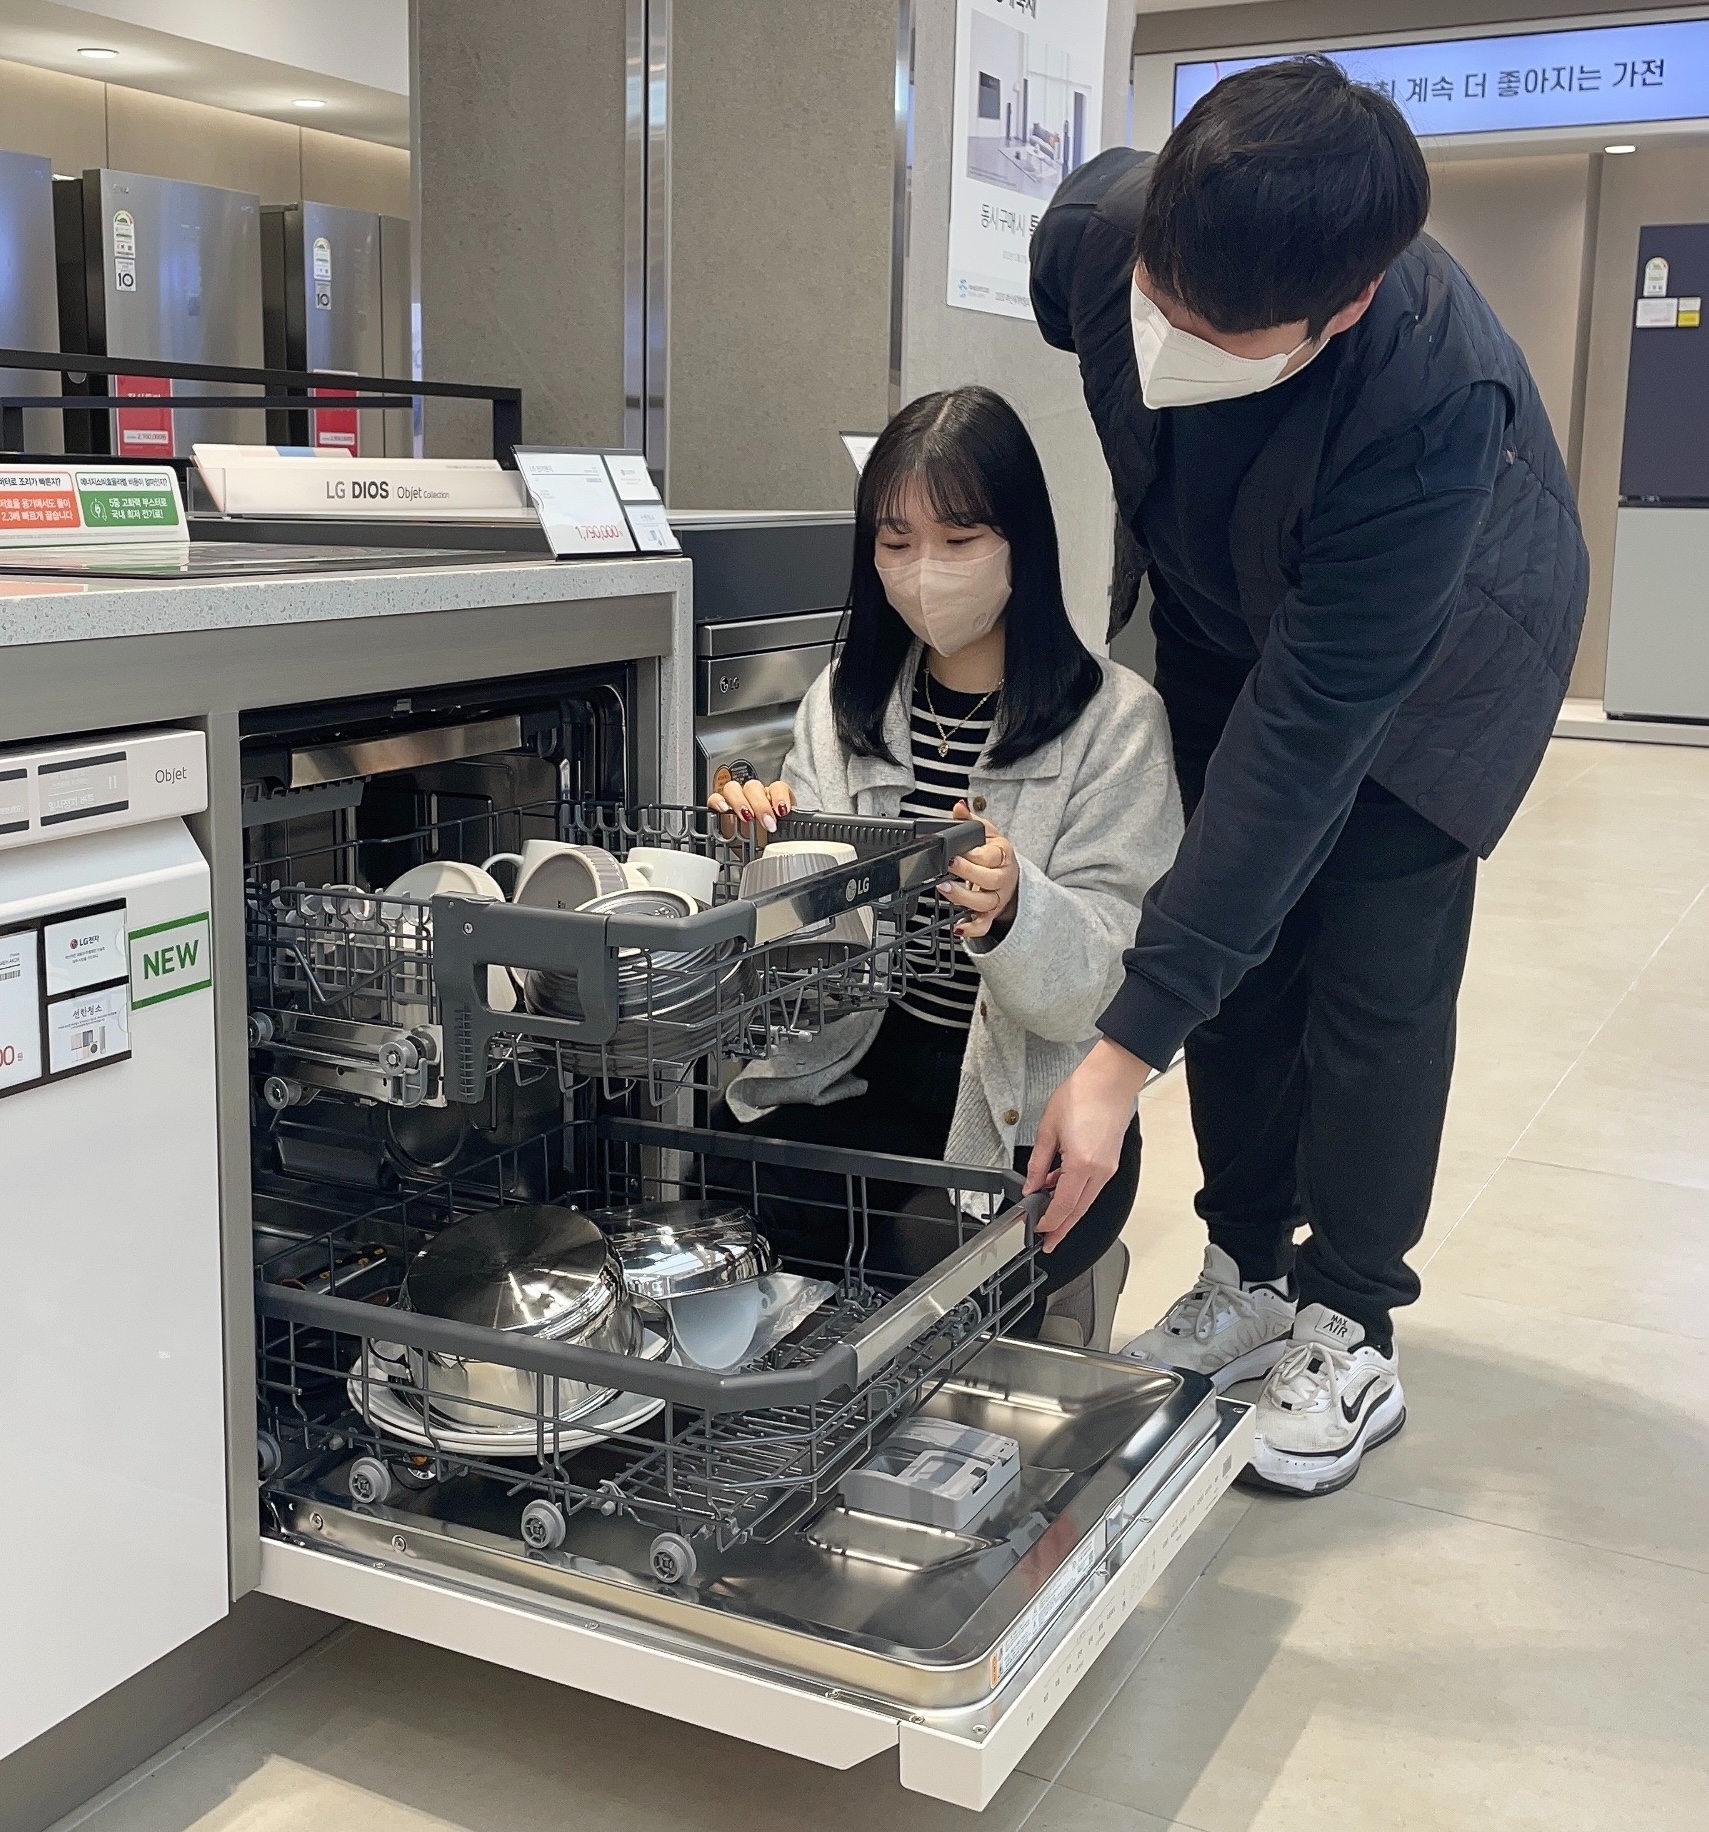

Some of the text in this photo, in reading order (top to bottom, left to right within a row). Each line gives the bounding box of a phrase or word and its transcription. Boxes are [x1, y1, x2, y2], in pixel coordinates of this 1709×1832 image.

[1406, 76, 1454, 102] 계속
[1464, 73, 1487, 98] 더
[1498, 65, 1602, 97] 좋아지는
[1612, 58, 1665, 87] 가전
[326, 481, 450, 501] LG DIOS Objet Collection
[155, 766, 187, 784] Objet
[142, 938, 200, 981] NEW
[1322, 1321, 1348, 1338] AIR
[1330, 1314, 1348, 1327] MAX
